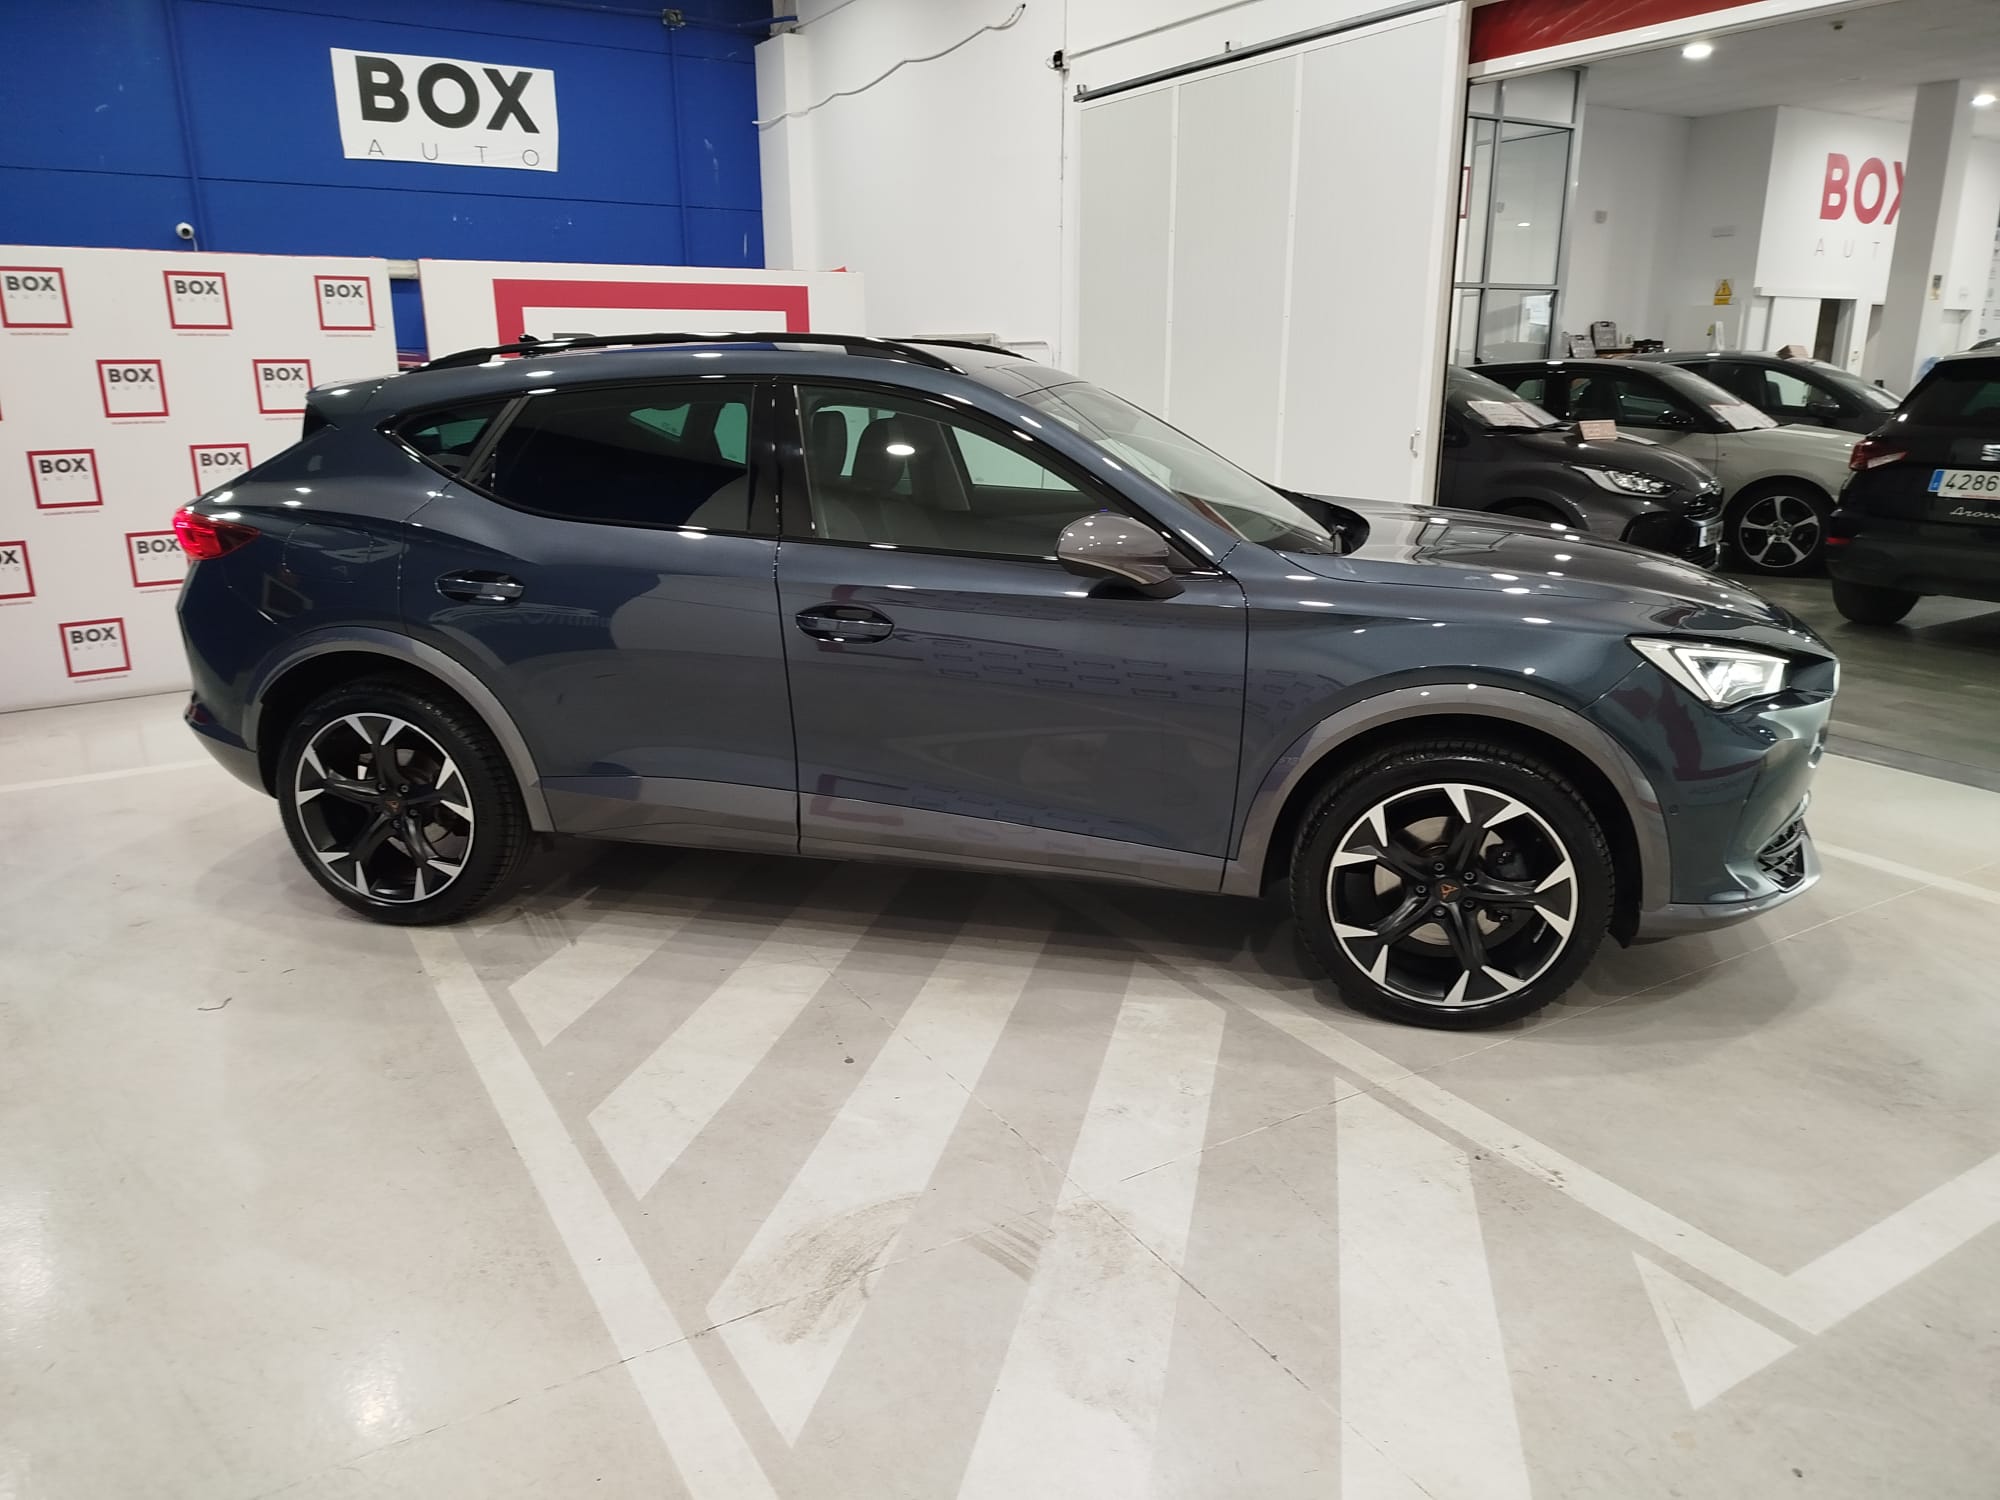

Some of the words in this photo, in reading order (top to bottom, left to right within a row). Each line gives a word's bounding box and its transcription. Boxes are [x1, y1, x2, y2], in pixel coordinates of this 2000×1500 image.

[355, 55, 541, 134] BOX
[367, 138, 540, 166] AUTO
[5, 275, 56, 292] BOX
[174, 279, 219, 295] BOX
[323, 284, 364, 298] BOX
[108, 367, 155, 383] BOX
[262, 367, 304, 381] BOX
[38, 457, 88, 474] BOX
[200, 451, 243, 467] BOX
[1945, 473, 2000, 492] 4286
[136, 538, 181, 554] BOX
[69, 626, 117, 644] BOX
